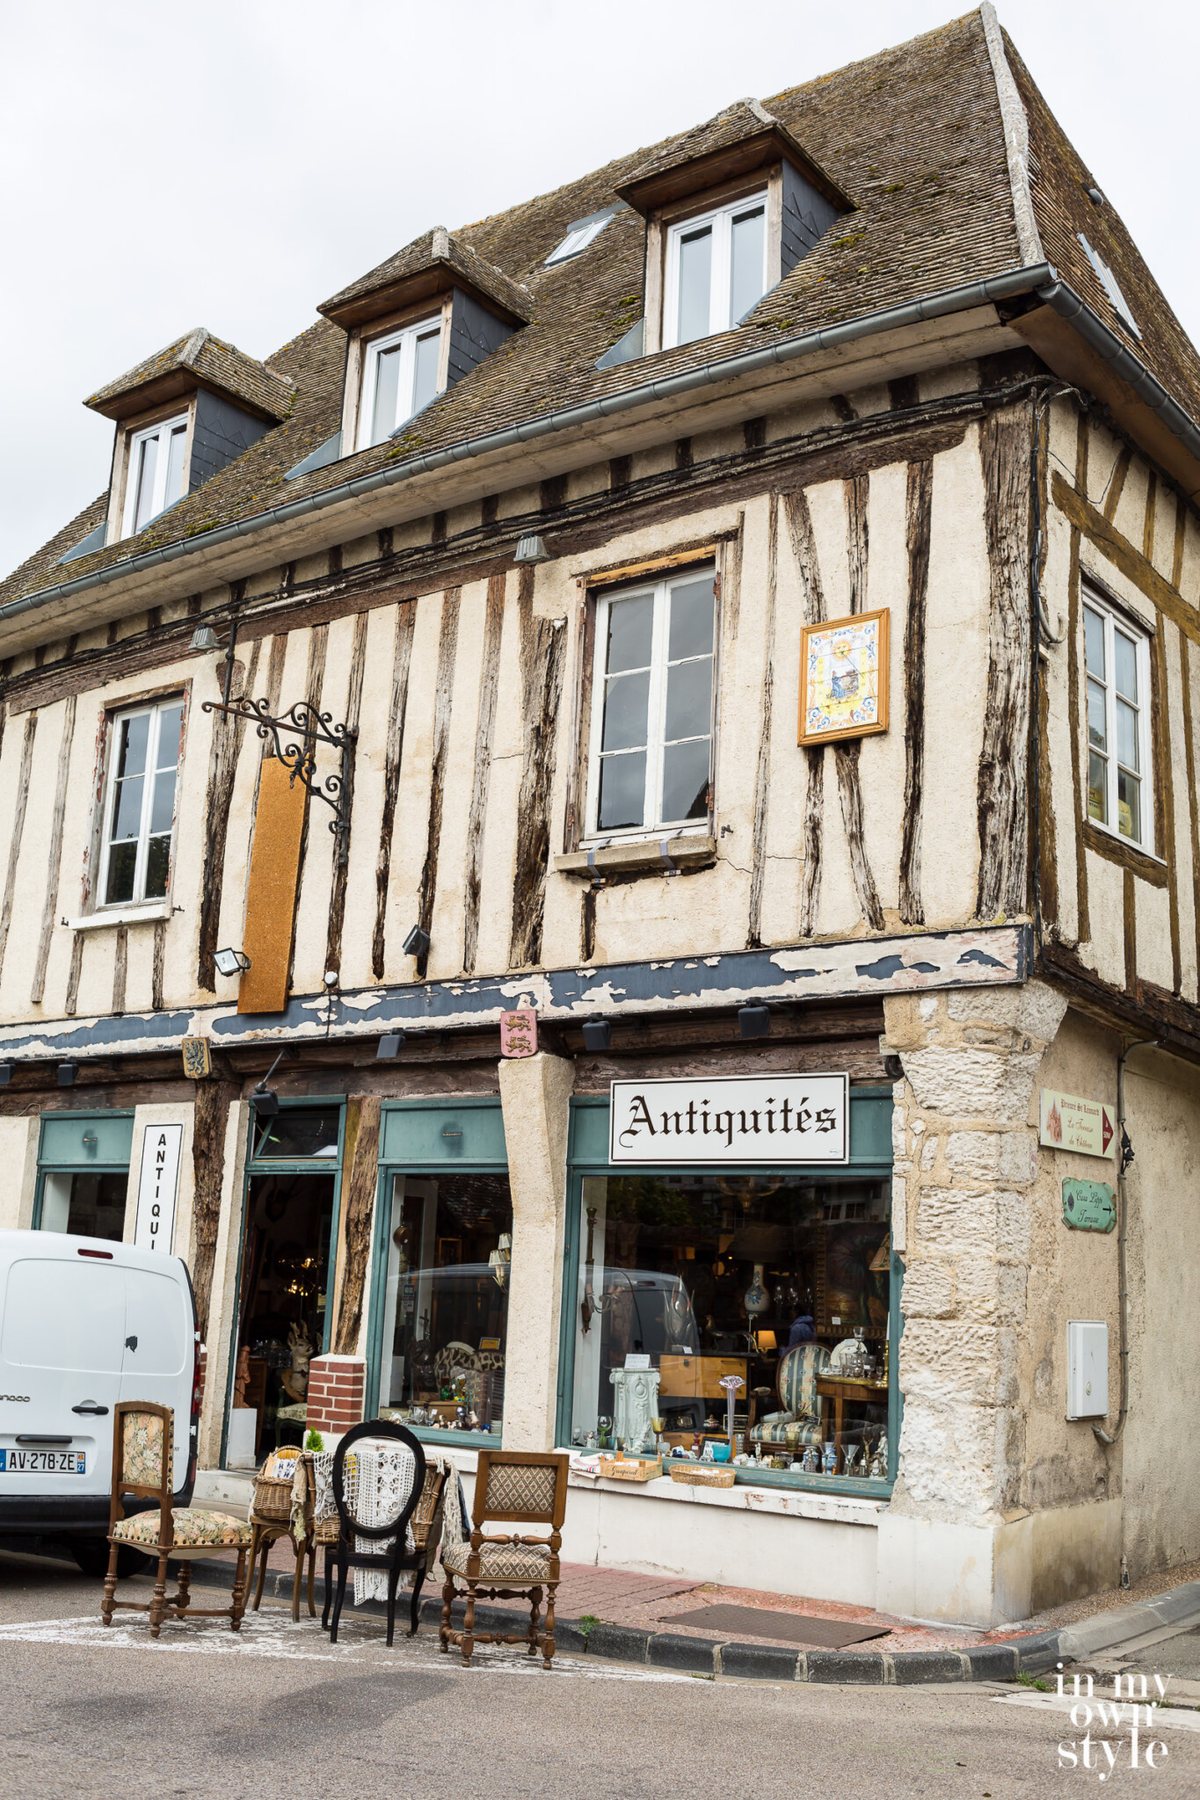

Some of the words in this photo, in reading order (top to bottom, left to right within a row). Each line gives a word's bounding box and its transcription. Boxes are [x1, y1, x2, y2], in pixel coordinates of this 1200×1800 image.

[618, 1095, 838, 1149] Antiquités
[9, 1452, 76, 1471] AV-278-ZE
[77, 1462, 85, 1472] 27
